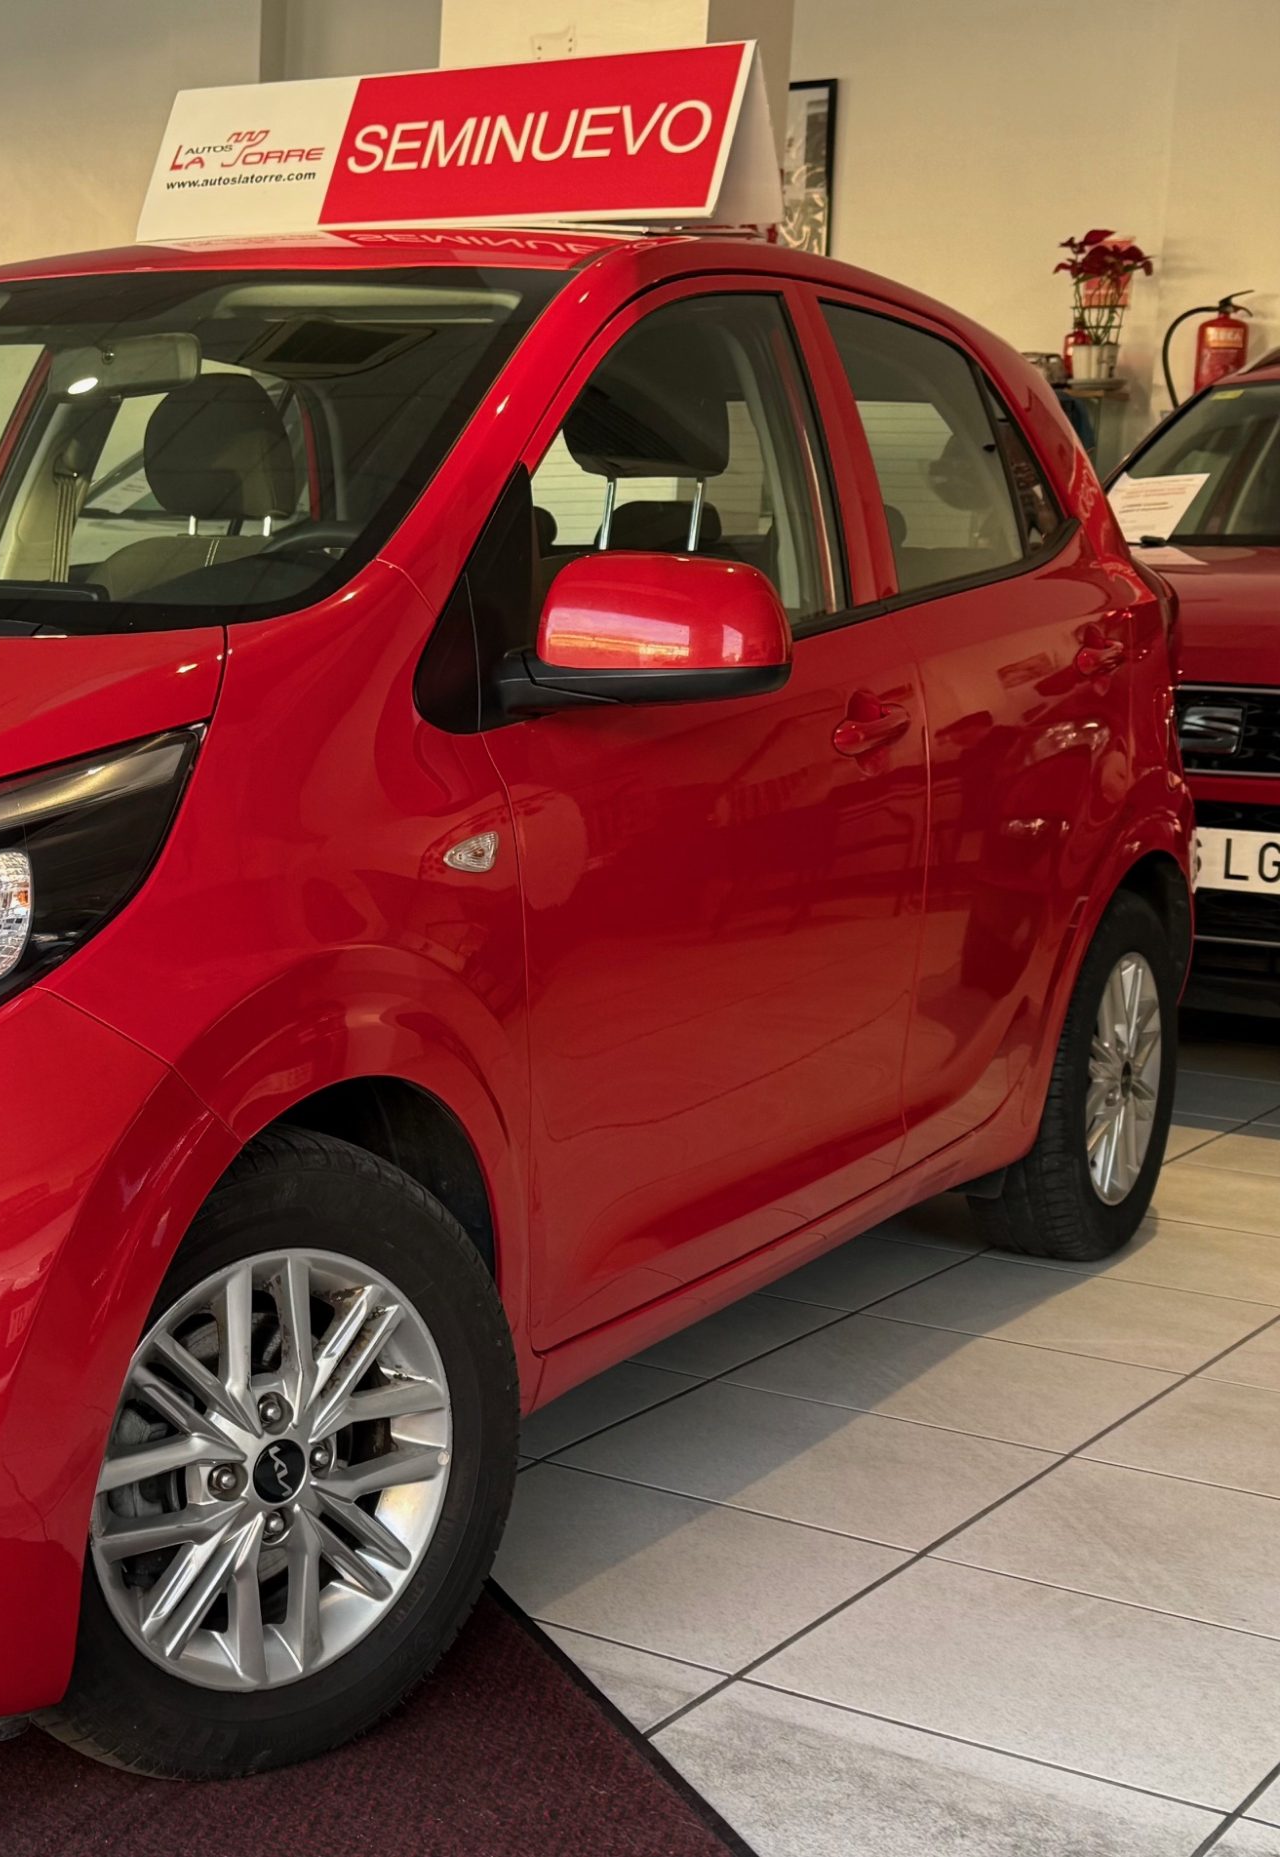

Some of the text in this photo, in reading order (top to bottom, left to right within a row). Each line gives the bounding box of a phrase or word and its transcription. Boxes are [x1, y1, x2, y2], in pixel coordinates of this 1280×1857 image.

[346, 98, 713, 174] SEMINUEVO
[169, 144, 206, 172] LA
[184, 144, 233, 156] AUTOS
[166, 171, 317, 190] www.autoslatorre.com
